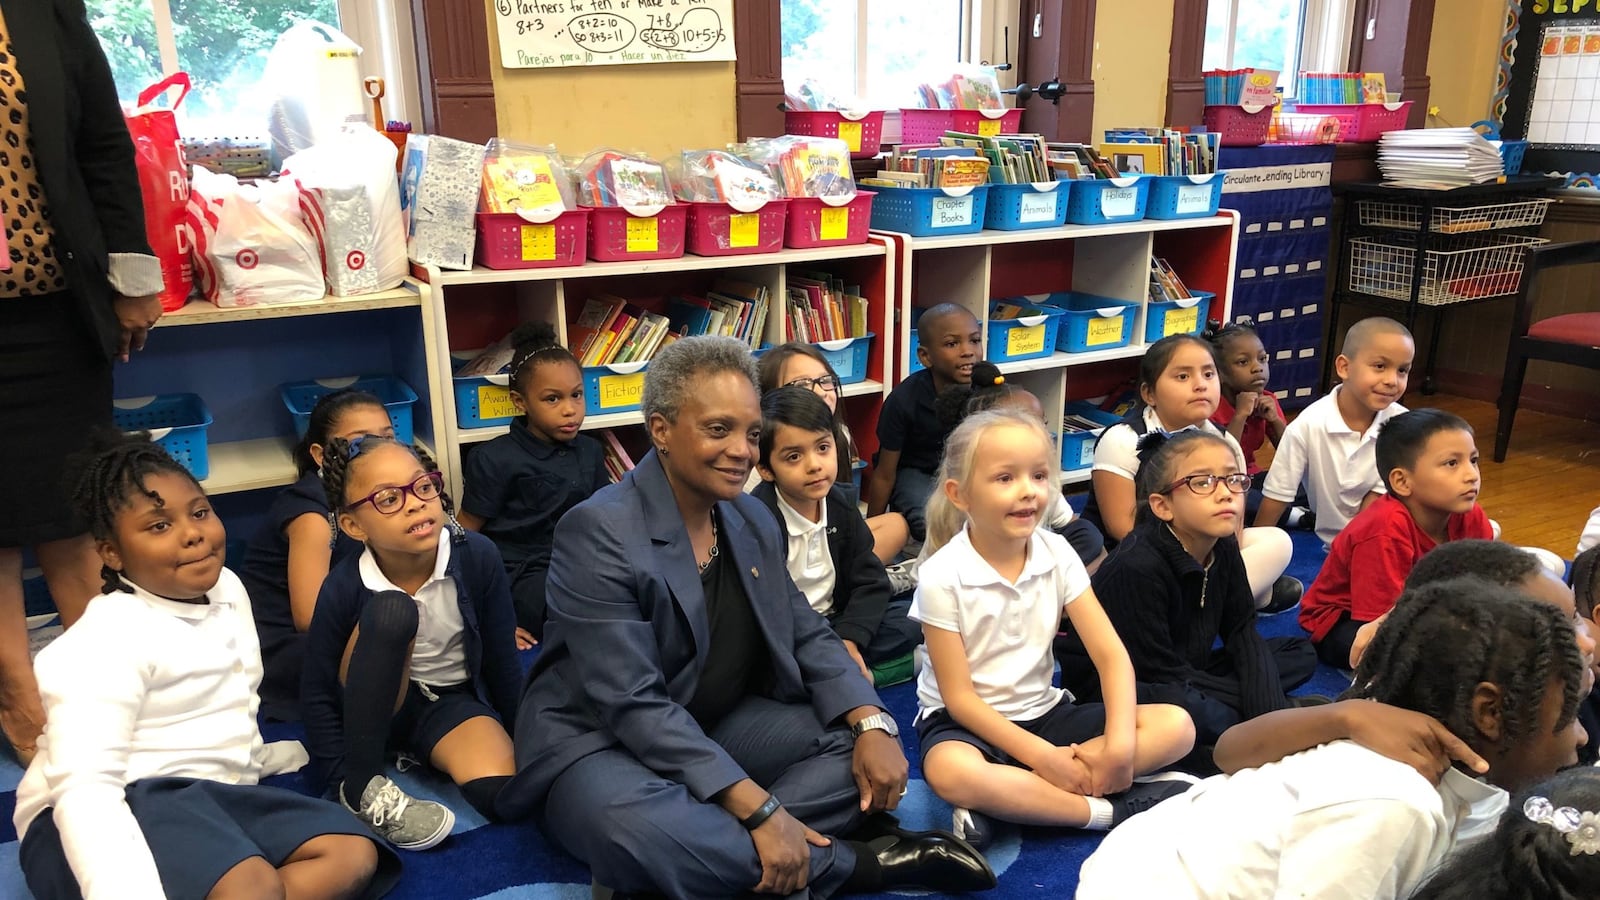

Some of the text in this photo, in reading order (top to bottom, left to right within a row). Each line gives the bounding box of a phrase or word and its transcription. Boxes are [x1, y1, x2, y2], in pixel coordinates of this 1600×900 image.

[1533, 0, 1600, 14] SEP
[516, 18, 545, 35] 8+3
[1223, 168, 1324, 186] Circulante ending Library
[1180, 192, 1209, 204] Animals
[936, 199, 966, 211] Chapter
[1023, 203, 1053, 215] Animals
[940, 211, 965, 223] Books
[1011, 331, 1031, 342] Solar
[1016, 342, 1041, 352] System
[483, 391, 509, 405] Awar
